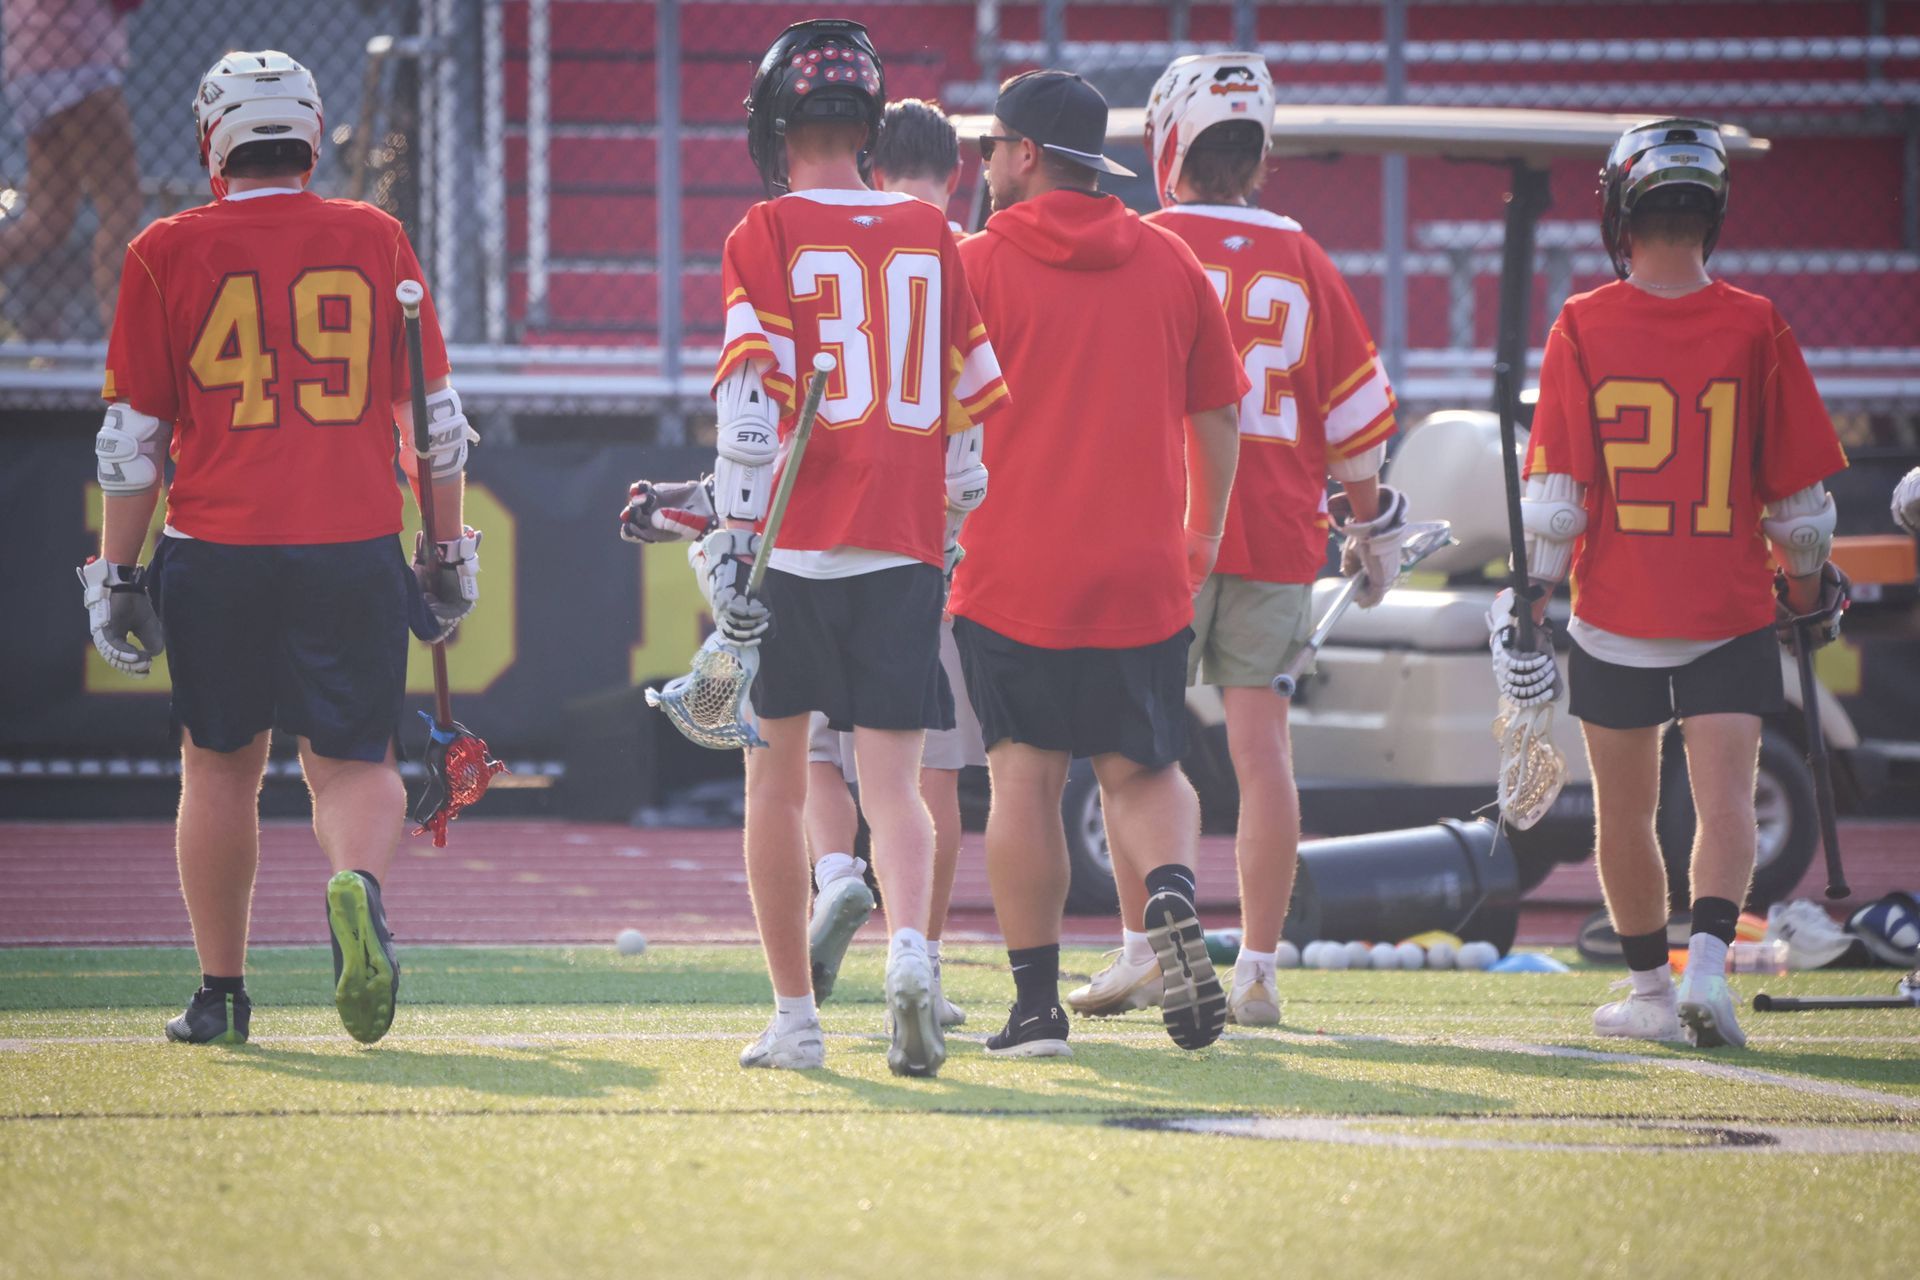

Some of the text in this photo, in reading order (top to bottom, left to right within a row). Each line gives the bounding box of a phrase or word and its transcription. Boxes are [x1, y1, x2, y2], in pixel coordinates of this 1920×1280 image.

[187, 265, 376, 432] 49
[787, 244, 942, 436] 30
[736, 431, 770, 445] STX
[961, 487, 986, 501] STX
[1592, 375, 1742, 538] 21
